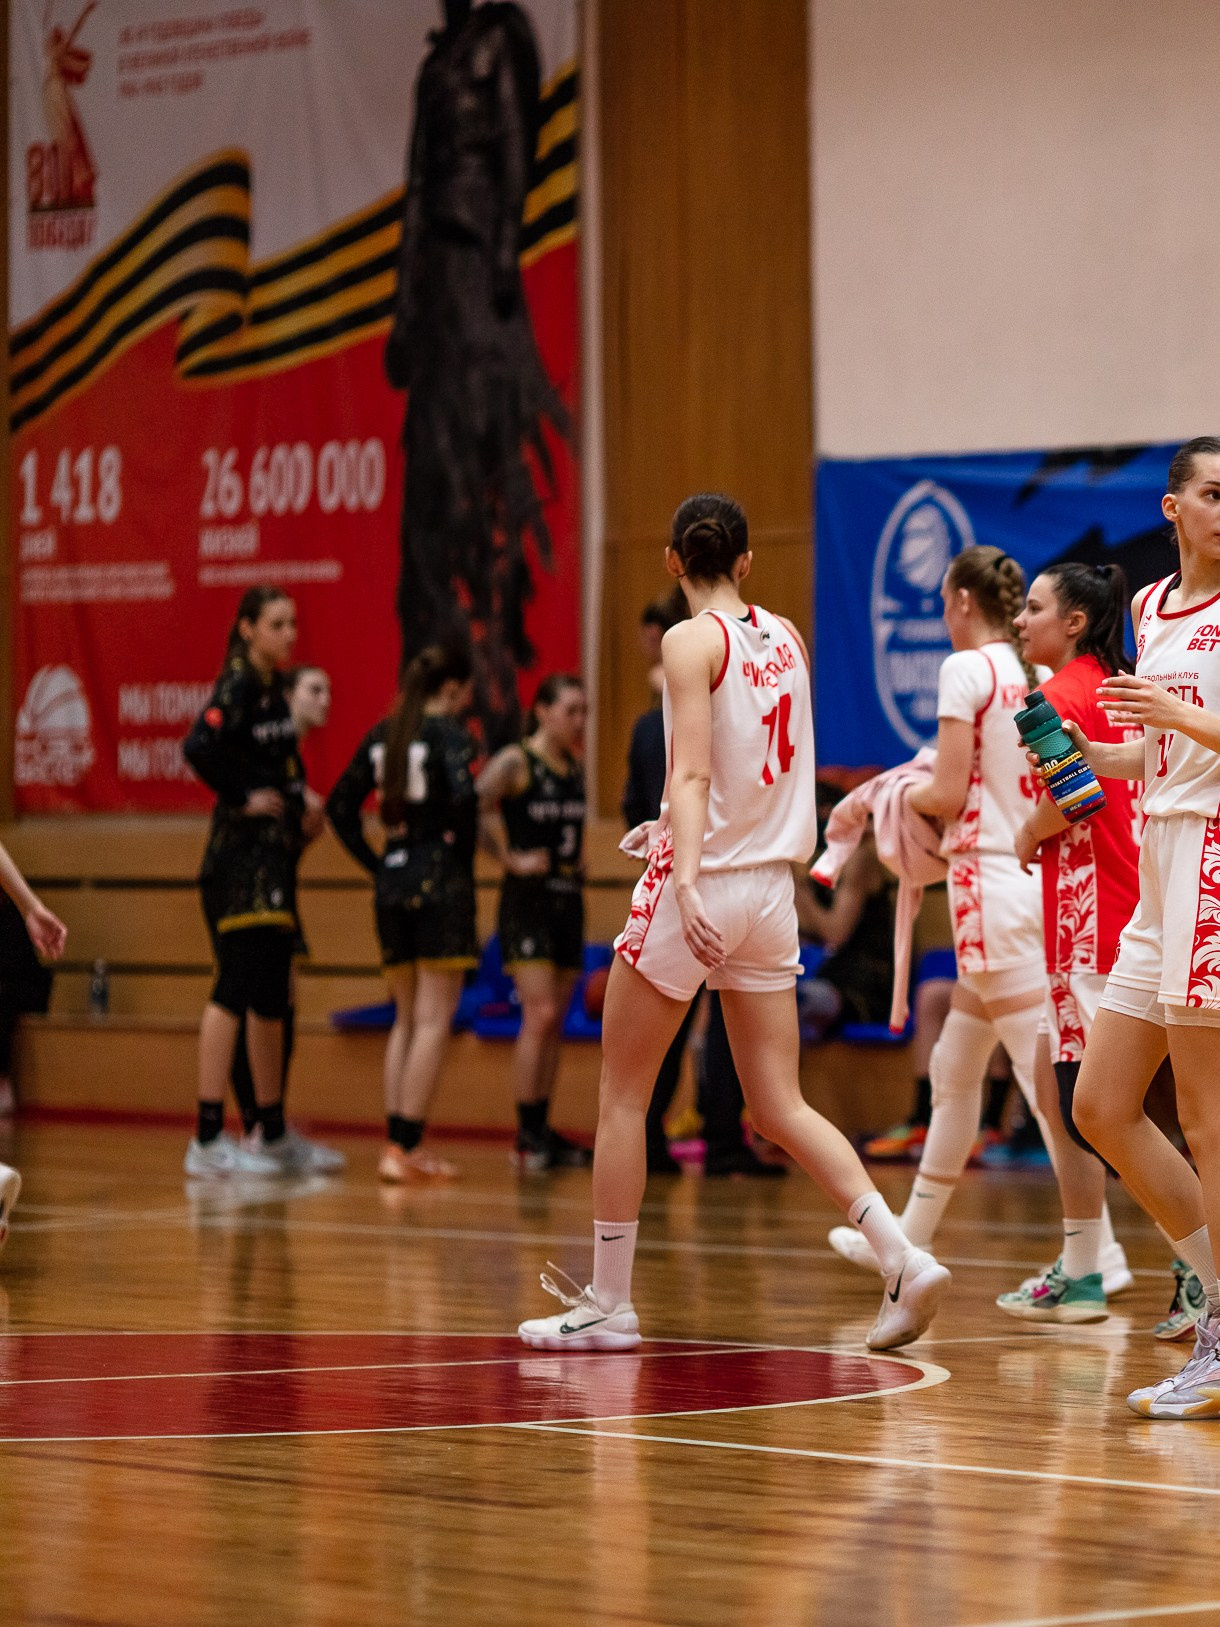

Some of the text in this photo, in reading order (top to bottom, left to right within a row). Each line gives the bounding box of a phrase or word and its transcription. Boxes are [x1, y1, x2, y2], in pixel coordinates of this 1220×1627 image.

[51, 444, 123, 525] 418
[200, 447, 244, 520] 26
[318, 436, 387, 515] 000
[1178, 671, 1200, 680] КЛУБ
